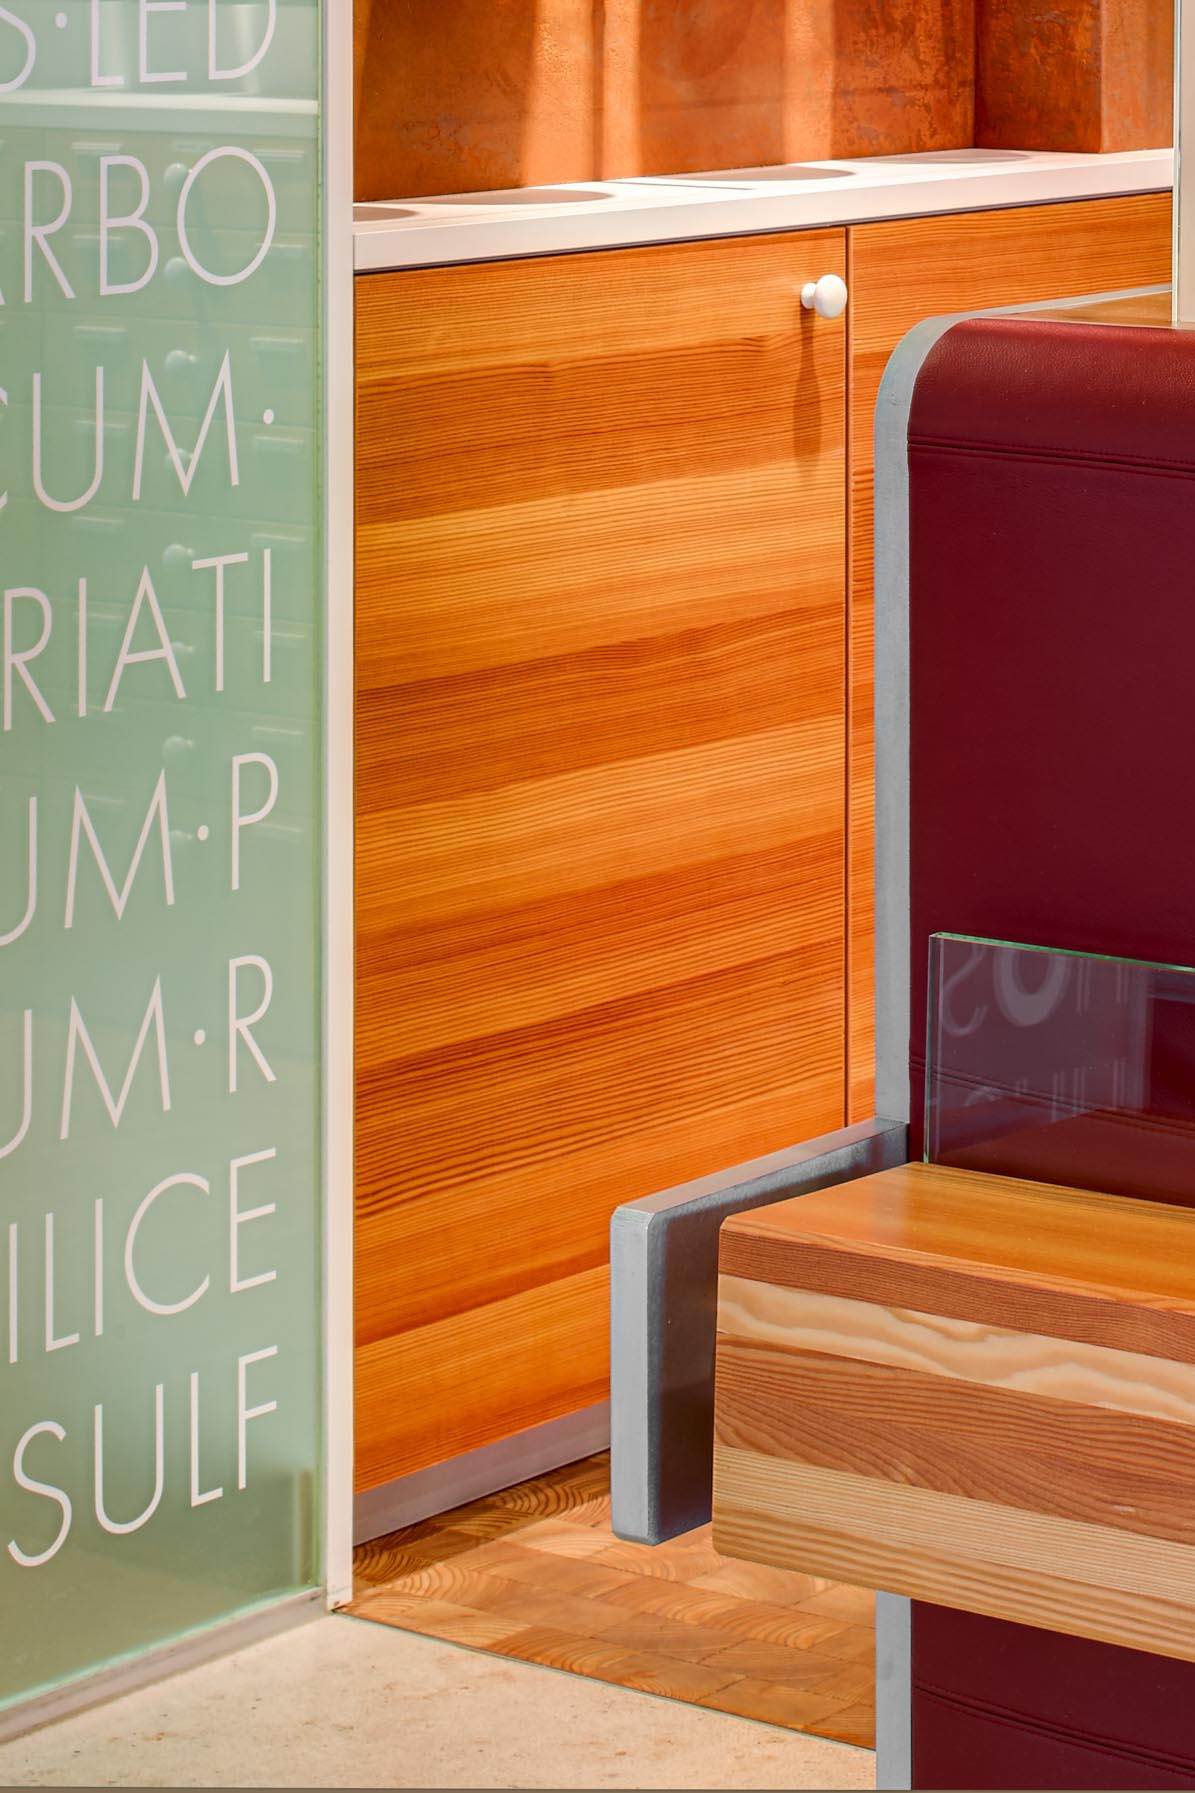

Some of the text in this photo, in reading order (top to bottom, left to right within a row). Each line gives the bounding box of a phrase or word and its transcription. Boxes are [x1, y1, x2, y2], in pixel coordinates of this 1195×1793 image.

[0, 146, 276, 305] RBO
[0, 348, 275, 512] UM·
[3, 548, 271, 732] RIATI
[9, 1147, 276, 1363] ILICE
[8, 1345, 277, 1567] SULF
